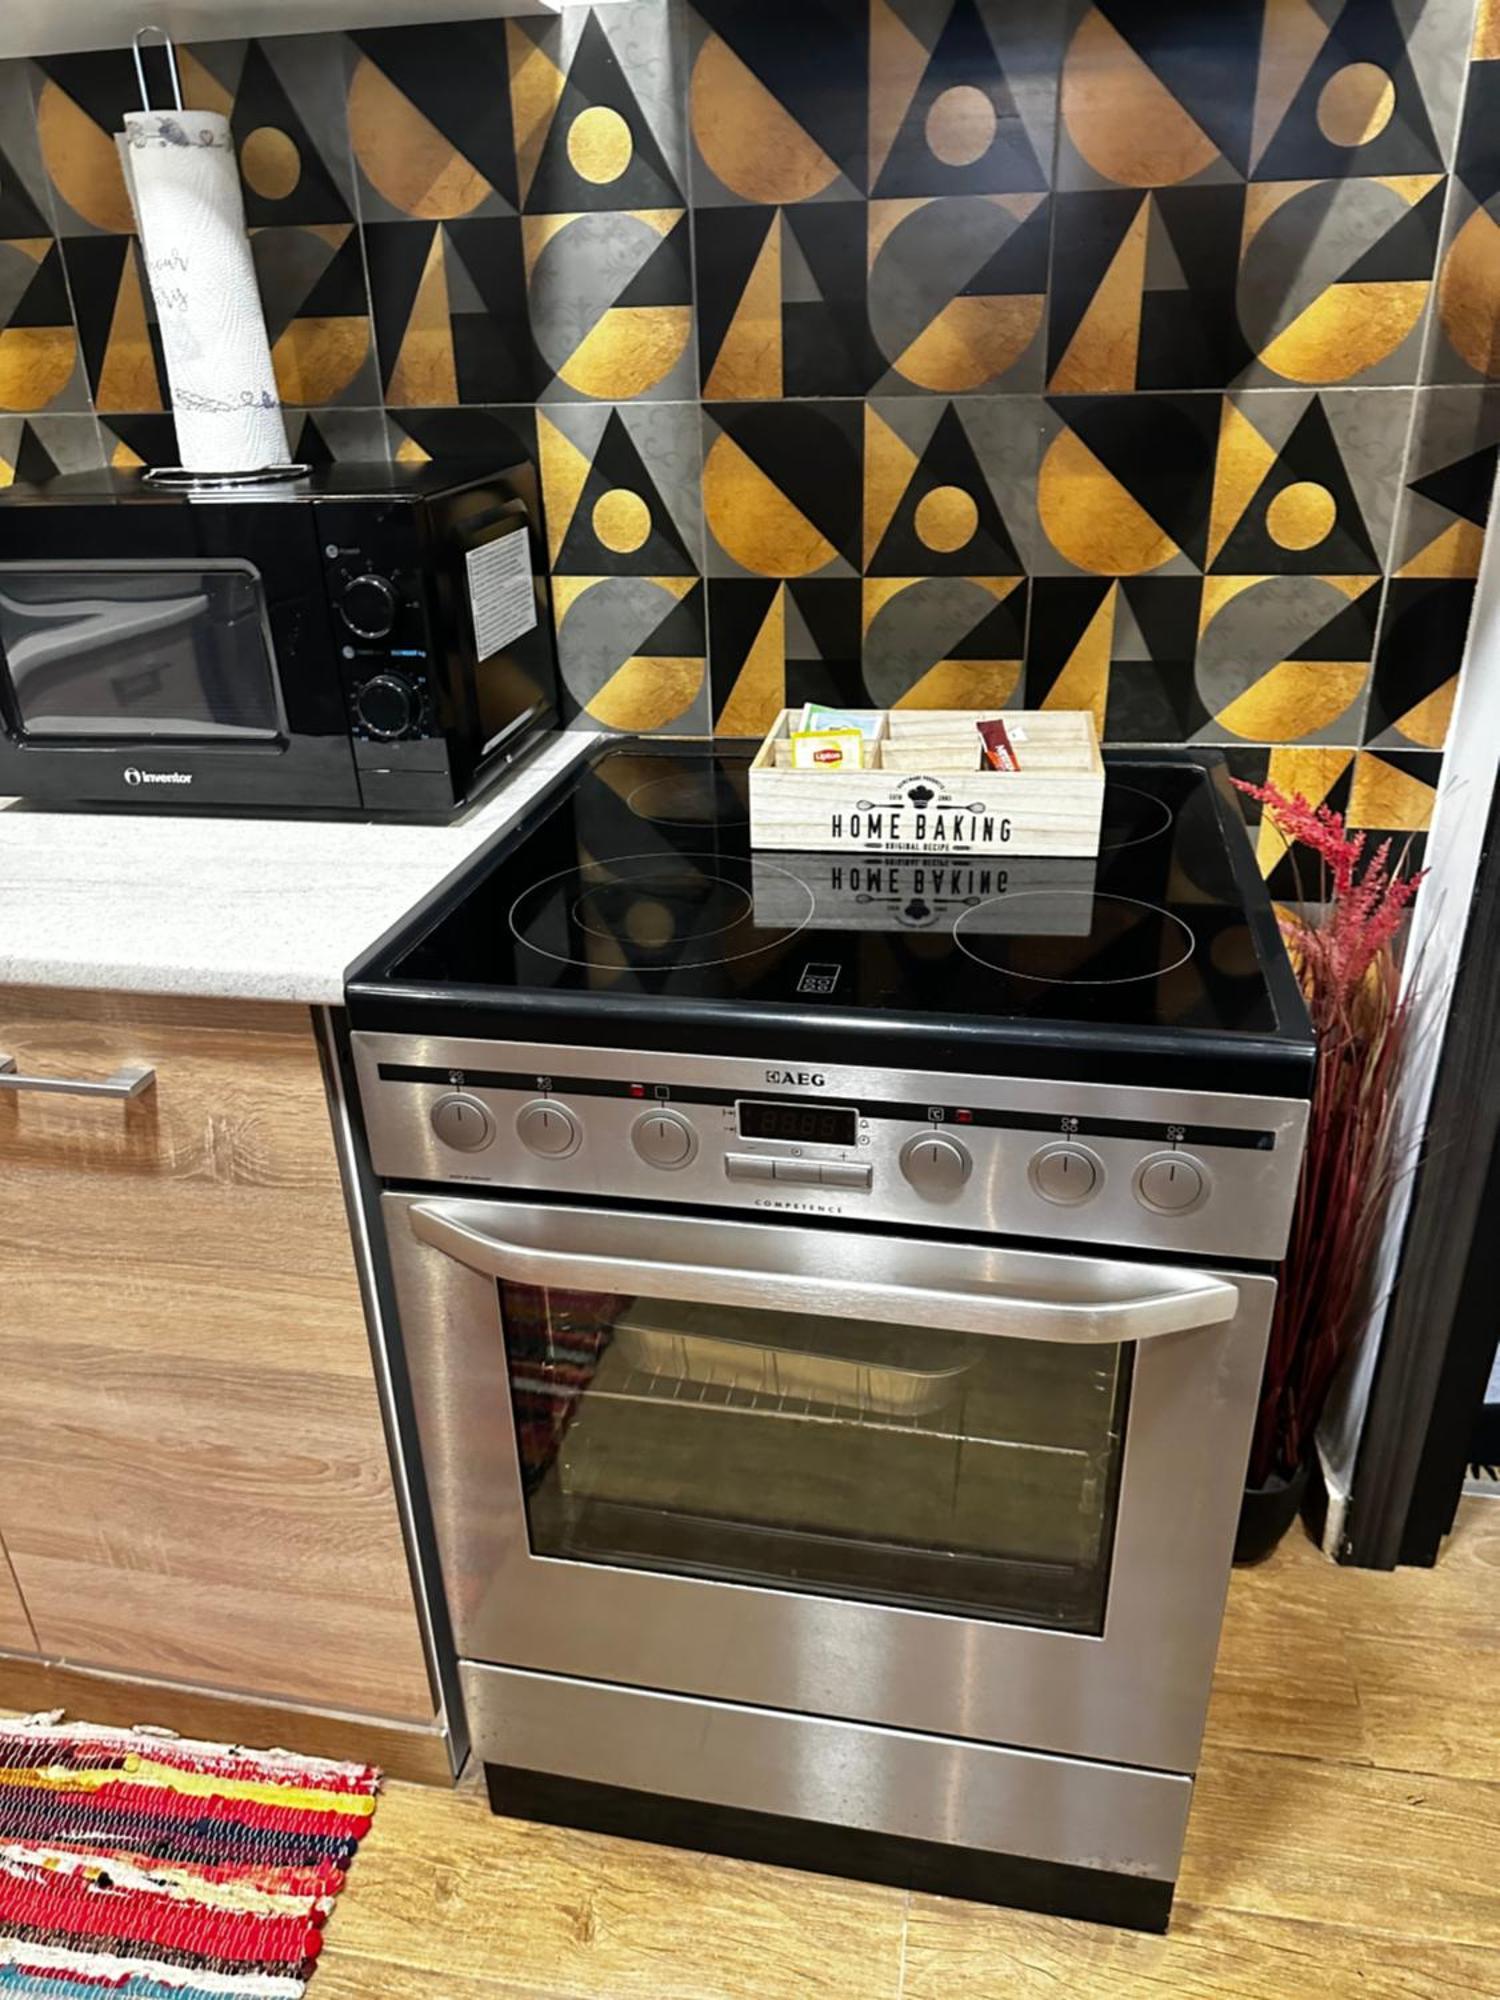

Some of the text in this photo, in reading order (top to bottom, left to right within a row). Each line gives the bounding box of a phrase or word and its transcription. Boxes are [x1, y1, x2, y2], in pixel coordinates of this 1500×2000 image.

[832, 813, 1011, 842] HOME BAKING
[885, 842, 949, 851] ORIGINAL RECIPE
[782, 1072, 825, 1087] AEG
[755, 1199, 842, 1213] COMPETENCE
